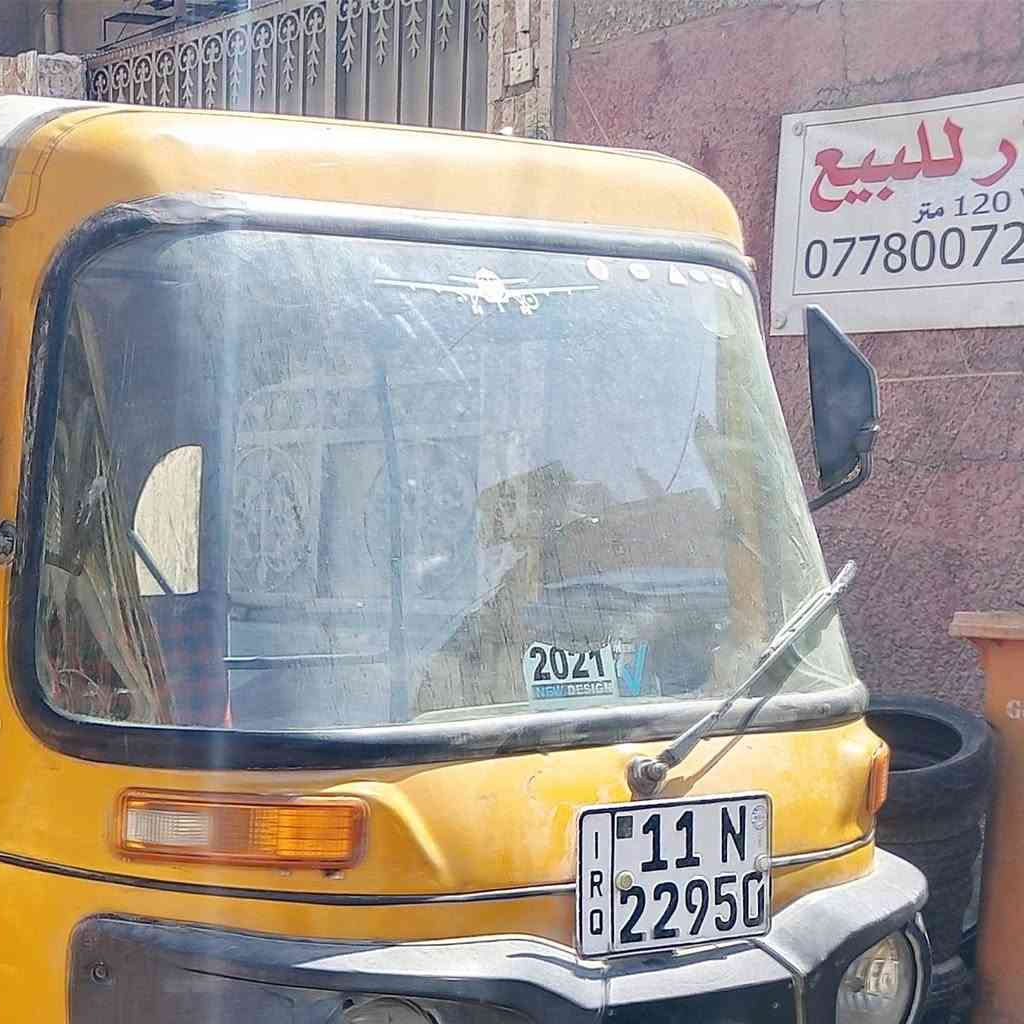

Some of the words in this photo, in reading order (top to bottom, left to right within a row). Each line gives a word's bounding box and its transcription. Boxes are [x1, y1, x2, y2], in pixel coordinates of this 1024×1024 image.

[809, 117, 964, 213] للبيع
[912, 202, 945, 223] متر
[954, 191, 1011, 217] 120
[529, 646, 605, 681] 2021
[641, 810, 701, 873] 11
[721, 804, 746, 863] N
[619, 871, 765, 944] 22950
